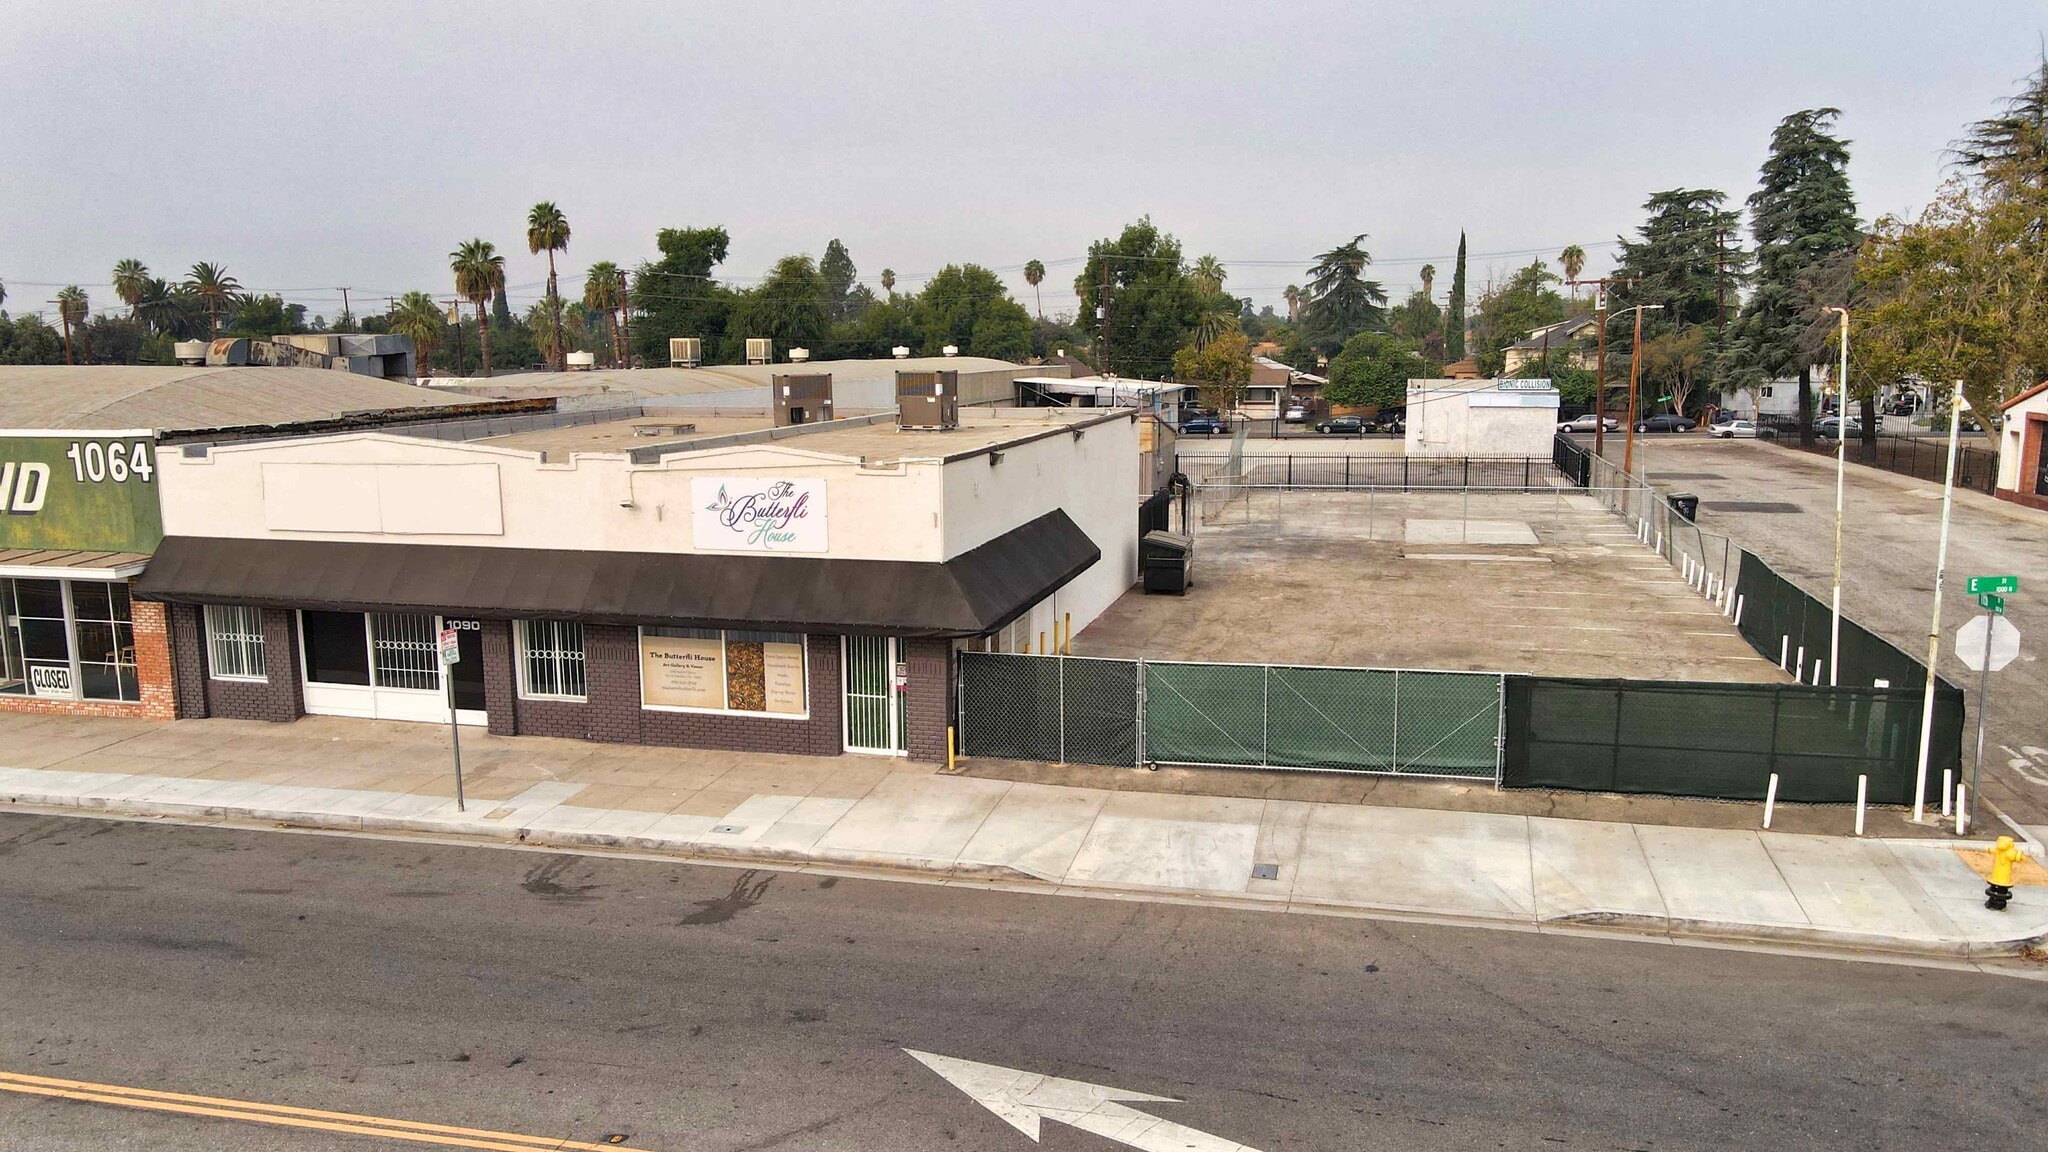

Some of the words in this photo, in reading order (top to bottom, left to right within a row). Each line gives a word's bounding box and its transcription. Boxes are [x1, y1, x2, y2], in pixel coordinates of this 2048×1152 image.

[1520, 380, 1551, 389] COLLISION
[66, 440, 153, 484] 1064
[767, 481, 797, 501] The
[719, 491, 809, 532] Butterfli
[747, 518, 797, 549] House
[1971, 578, 1979, 592] E
[446, 620, 480, 631] 1090
[649, 651, 663, 659] The
[694, 654, 716, 662] House
[33, 668, 70, 689] CLOSED
